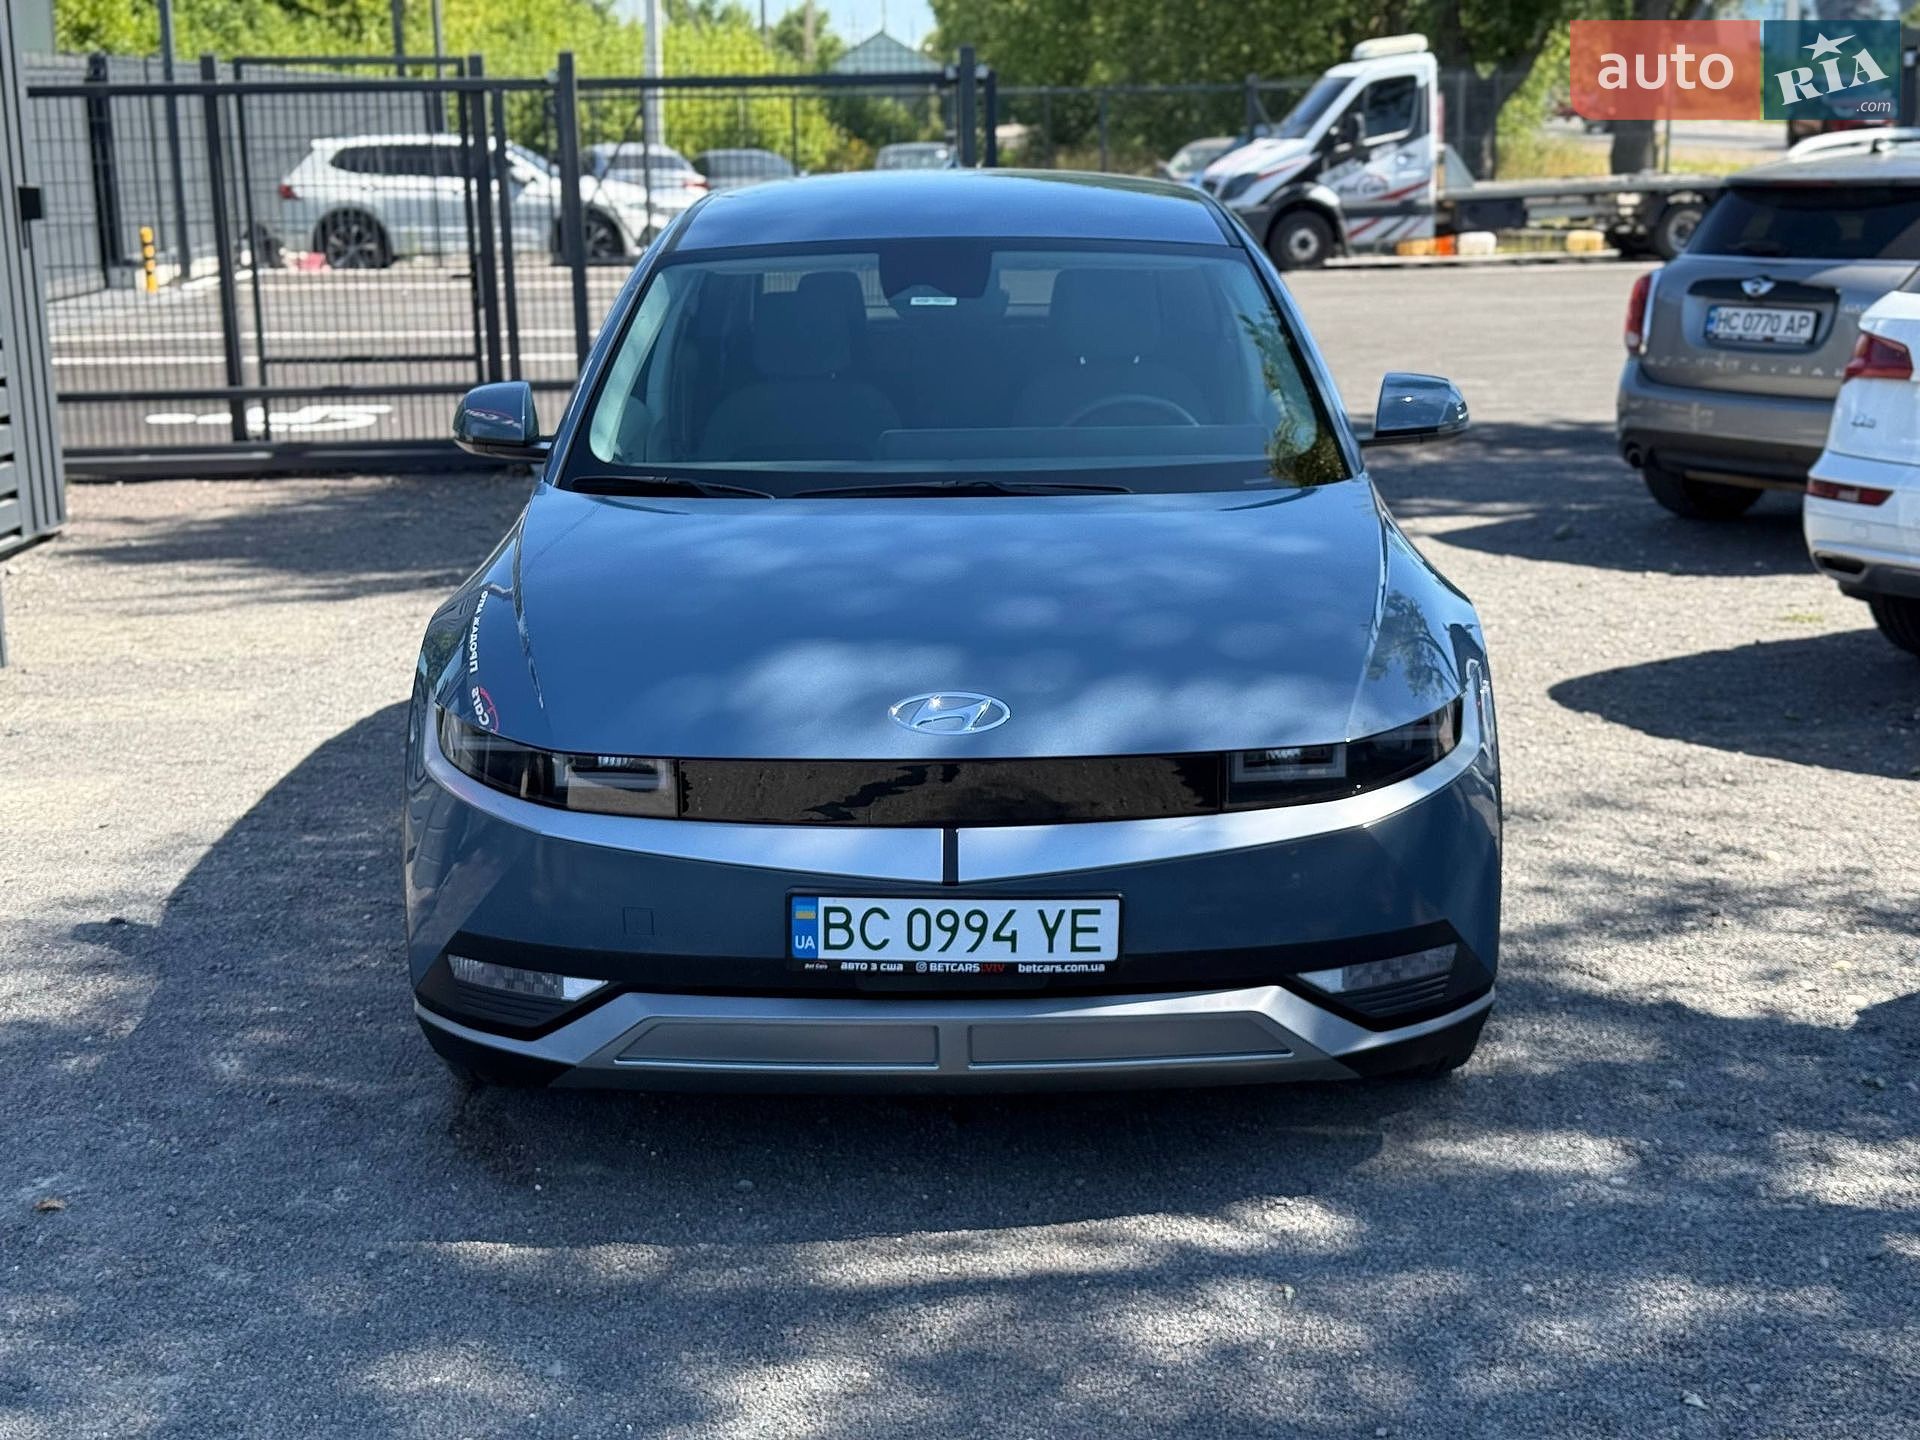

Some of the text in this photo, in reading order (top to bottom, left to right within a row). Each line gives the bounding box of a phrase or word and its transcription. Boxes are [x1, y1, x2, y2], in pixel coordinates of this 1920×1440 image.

[1742, 312, 1780, 333] 0770
[823, 906, 1101, 953] BC 0994 YE
[795, 935, 815, 950] UA
[1018, 963, 1105, 974] betcars.com.ua
